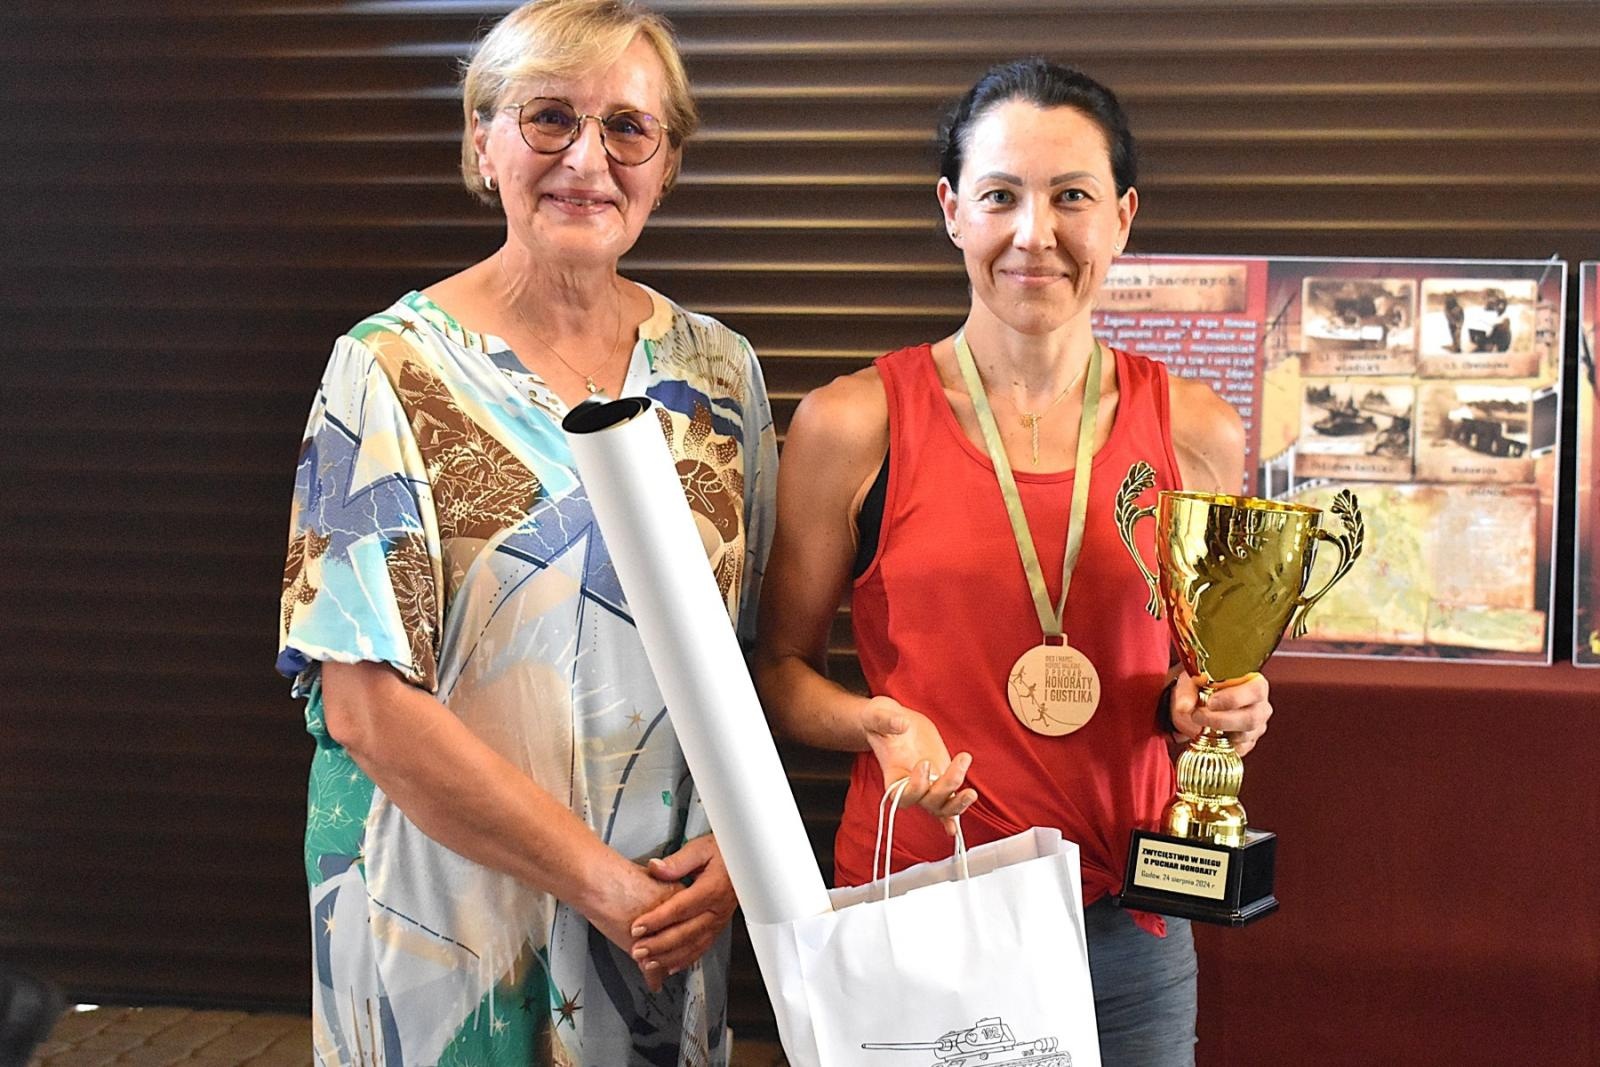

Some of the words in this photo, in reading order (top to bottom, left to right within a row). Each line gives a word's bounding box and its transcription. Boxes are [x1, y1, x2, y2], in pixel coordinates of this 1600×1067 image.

[1149, 274, 1237, 287] Pancernych
[1045, 676, 1093, 690] HONORATY
[1044, 689, 1049, 702] I
[1050, 689, 1093, 703] GUSTLIKA
[1142, 847, 1190, 862] ZWYCIĘSTWO
[1190, 855, 1199, 864] W
[1199, 857, 1221, 868] BIEGU
[1143, 857, 1149, 865] O
[1150, 858, 1179, 870] PUCHAR
[1179, 863, 1218, 876] HONORATY
[1162, 873, 1170, 881] 24
[1195, 879, 1210, 889] 2024
